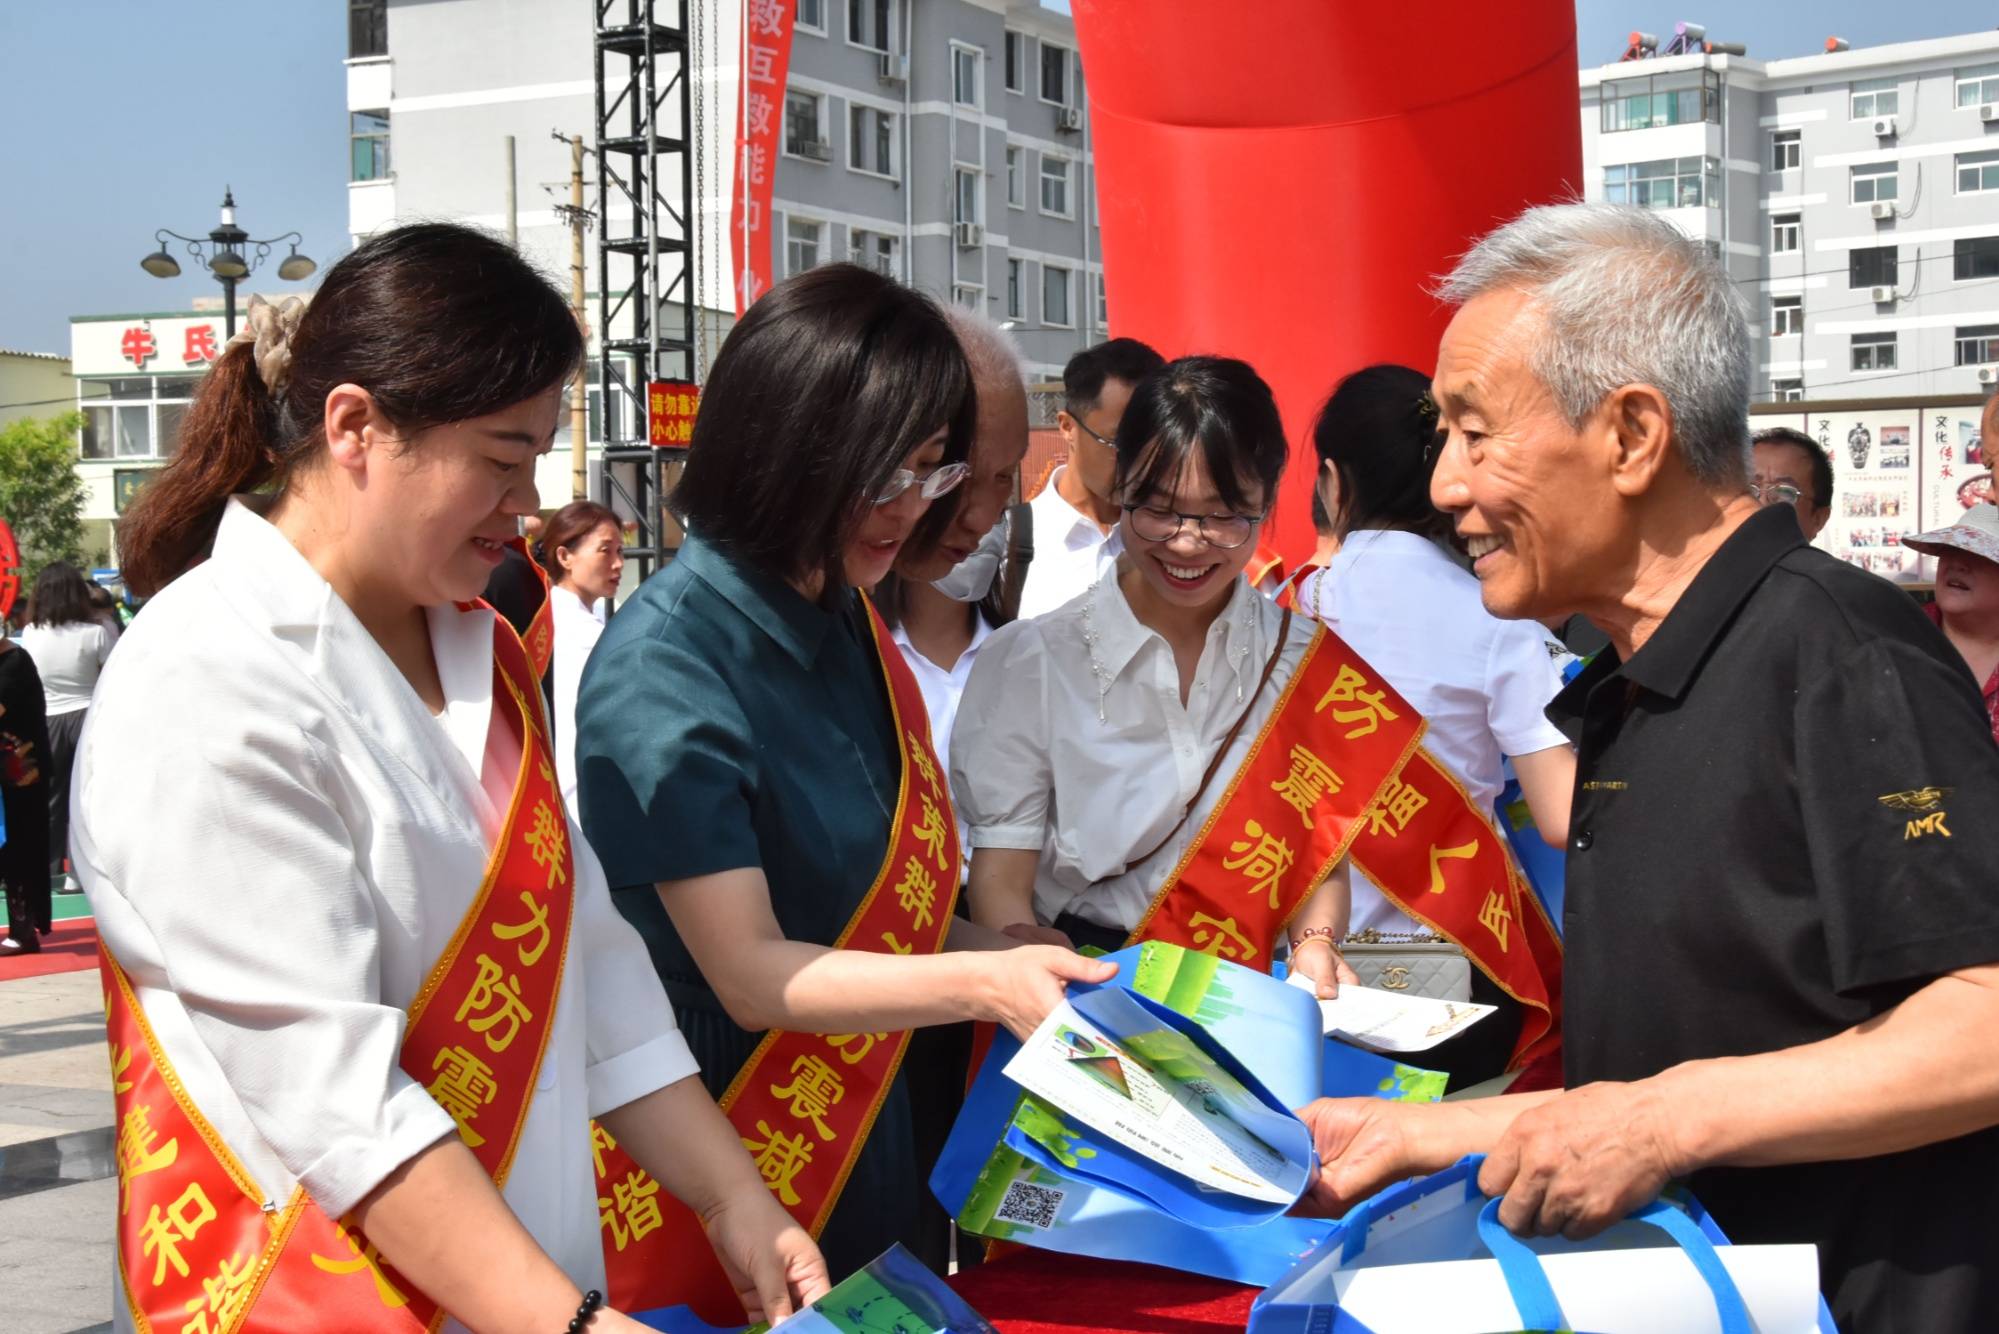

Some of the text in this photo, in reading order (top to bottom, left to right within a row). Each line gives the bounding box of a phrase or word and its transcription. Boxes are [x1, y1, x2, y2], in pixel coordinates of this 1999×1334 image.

[121, 323, 250, 366] 牛氏
[652, 419, 694, 441] 小心触
[1935, 415, 1954, 480] 文化传承
[1904, 812, 1952, 840] AMR
[104, 991, 257, 1334] 建和谐
